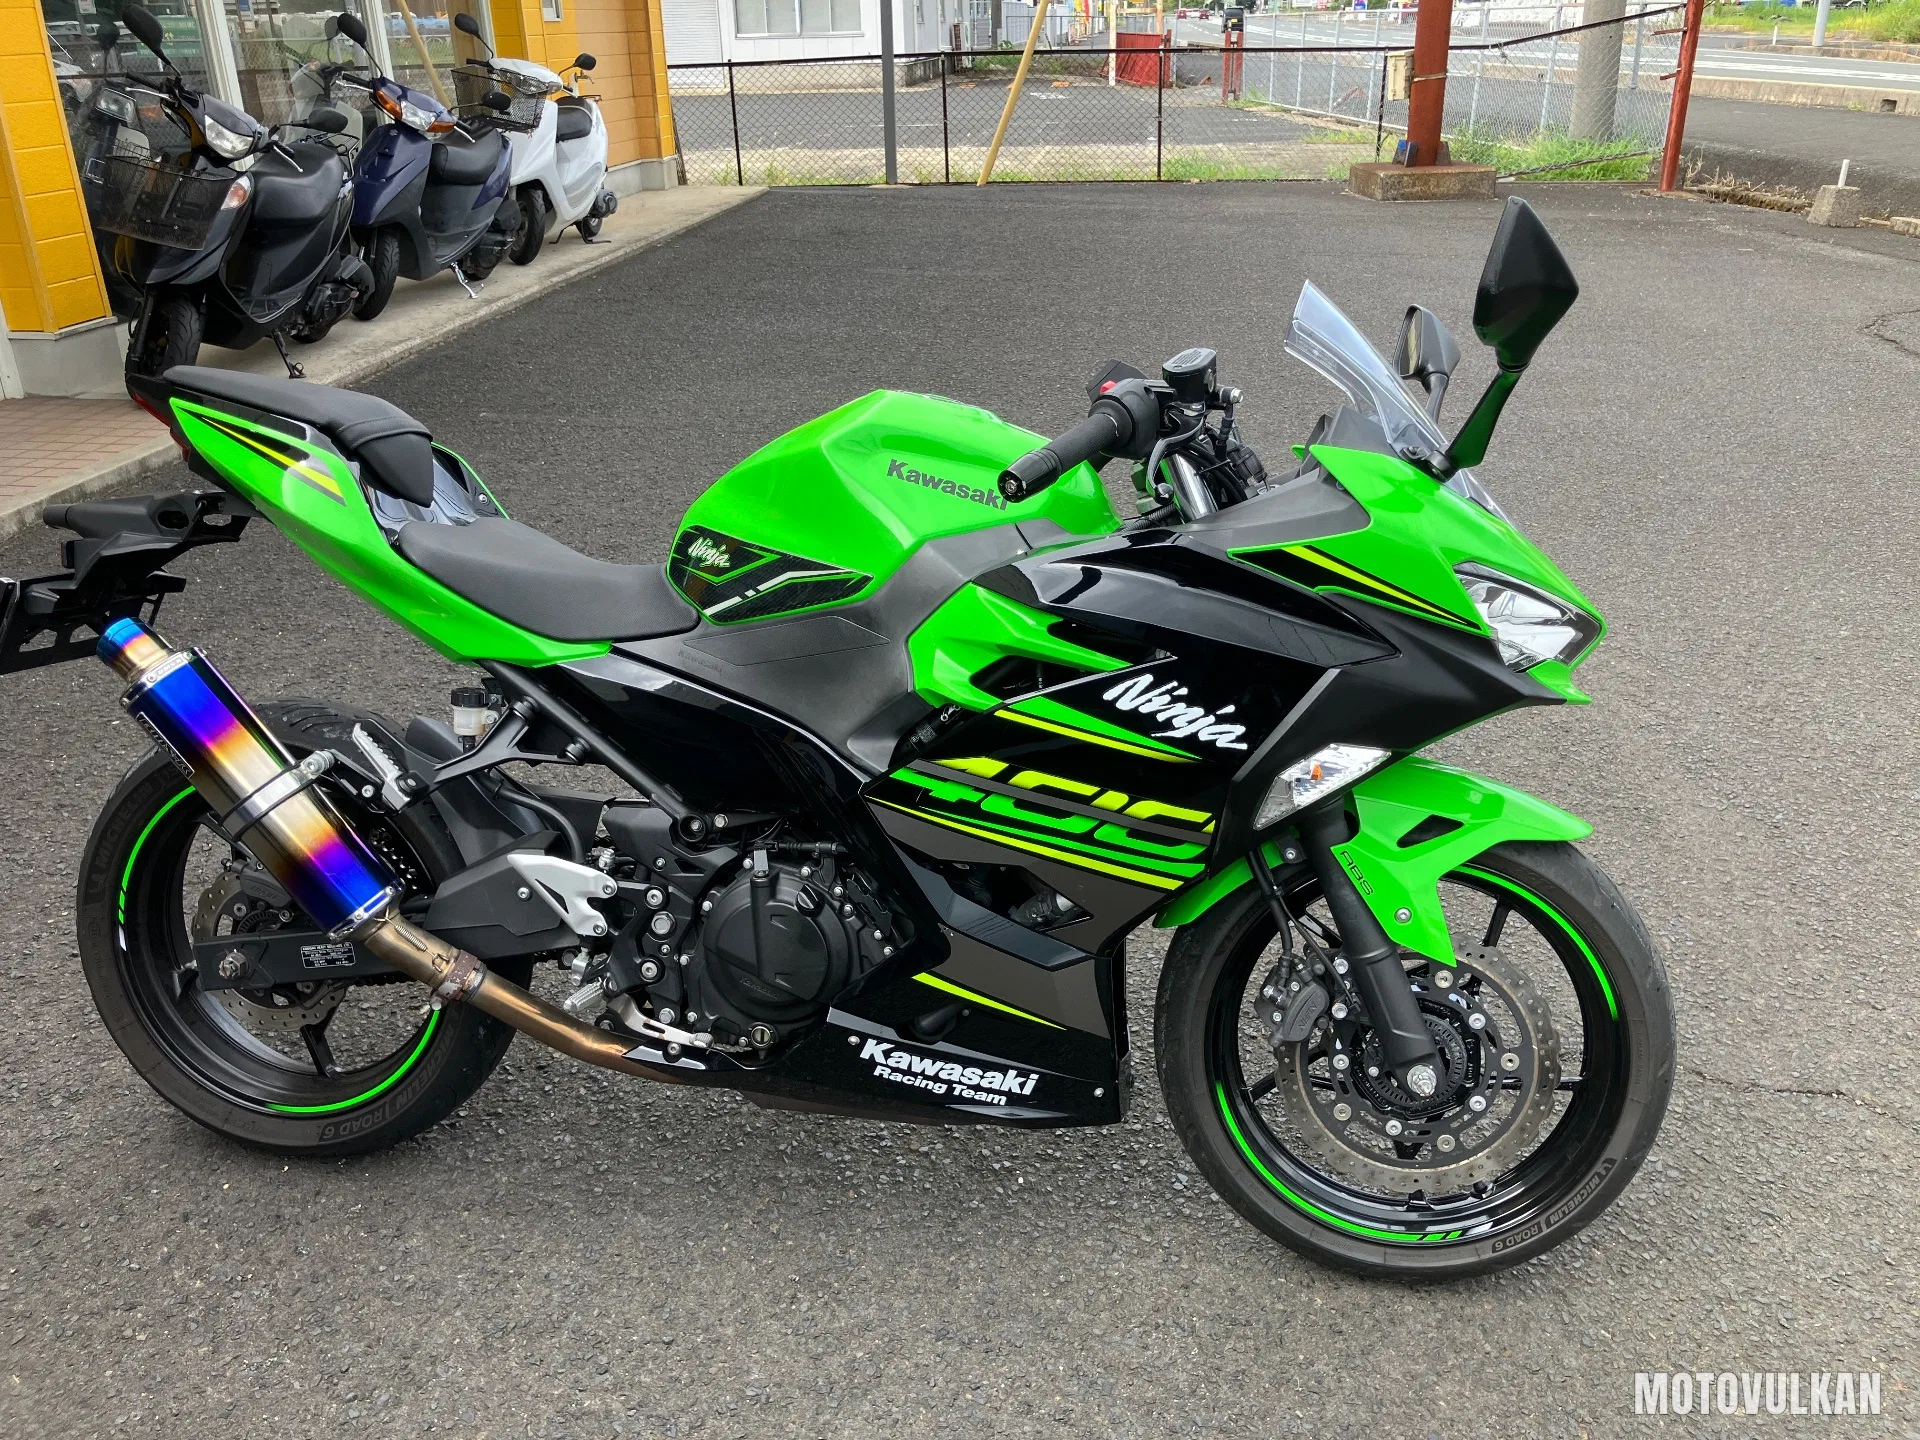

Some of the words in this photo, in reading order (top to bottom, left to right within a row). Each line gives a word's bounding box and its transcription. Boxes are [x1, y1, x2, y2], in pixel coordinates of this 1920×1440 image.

[886, 458, 1008, 511] Kawasaki
[687, 536, 730, 568] Ninja
[1102, 673, 1248, 750] Ninja
[889, 756, 1216, 860] 400
[1340, 850, 1374, 896] ABS
[859, 1038, 1039, 1096] Kawasaki
[873, 1065, 948, 1094] Racing
[951, 1083, 1007, 1106] Team
[322, 1126, 335, 1139] 6
[339, 1110, 383, 1135] ROAD
[1549, 1175, 1601, 1226] MICHELIN
[1494, 1242, 1504, 1251] 6
[1505, 1224, 1539, 1247] ROAD
